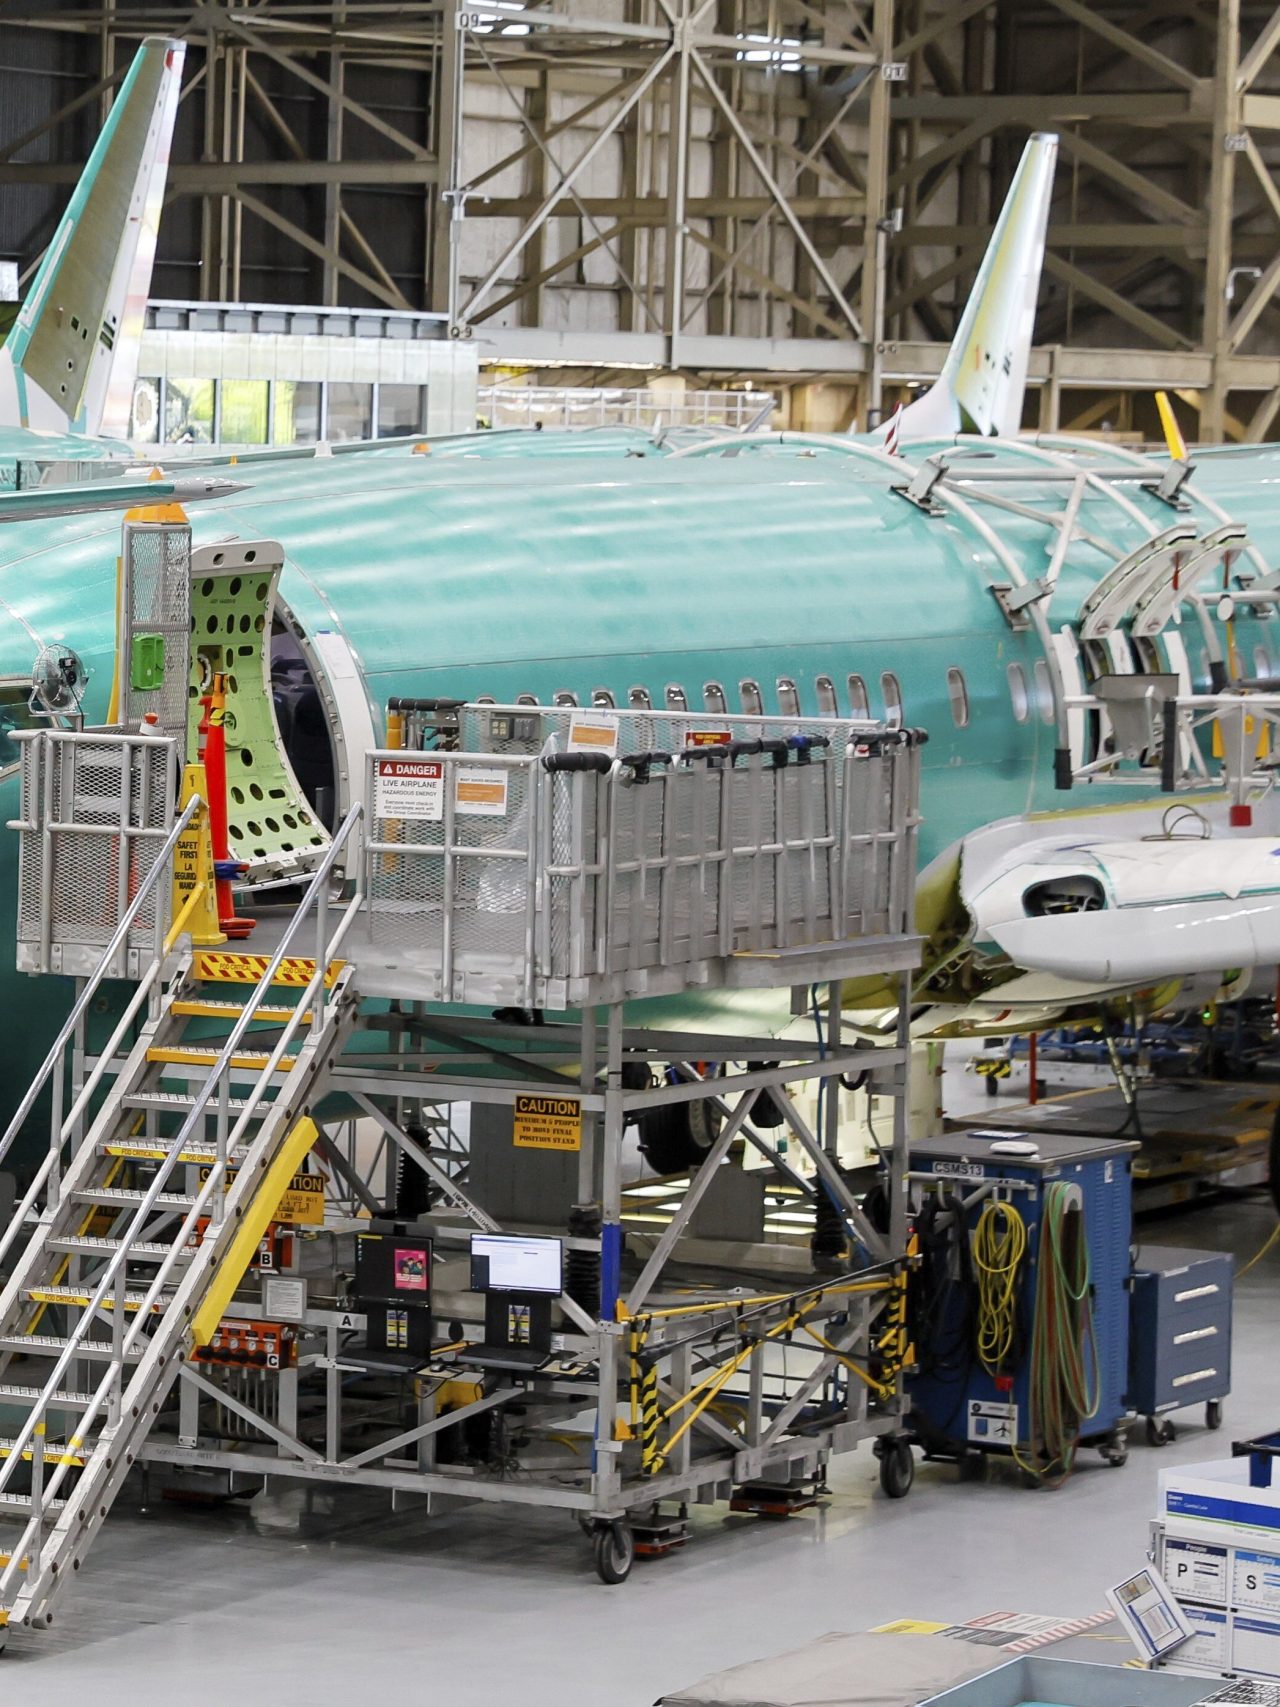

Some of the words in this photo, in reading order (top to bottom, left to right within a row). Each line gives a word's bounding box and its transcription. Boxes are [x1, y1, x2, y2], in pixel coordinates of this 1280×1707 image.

[396, 765, 437, 776] DANGER
[400, 781, 437, 789] AIRPLANE
[180, 851, 198, 859] FIRST
[184, 863, 192, 871] LA
[520, 1098, 576, 1115] CAUTION
[520, 1135, 551, 1143] POSITION
[935, 1162, 982, 1177] CSMS13
[262, 1254, 270, 1265] B
[342, 1315, 352, 1326] A
[269, 1356, 277, 1366] C
[1185, 1544, 1207, 1553] People
[1178, 1563, 1188, 1577] P
[1246, 1575, 1256, 1590] S
